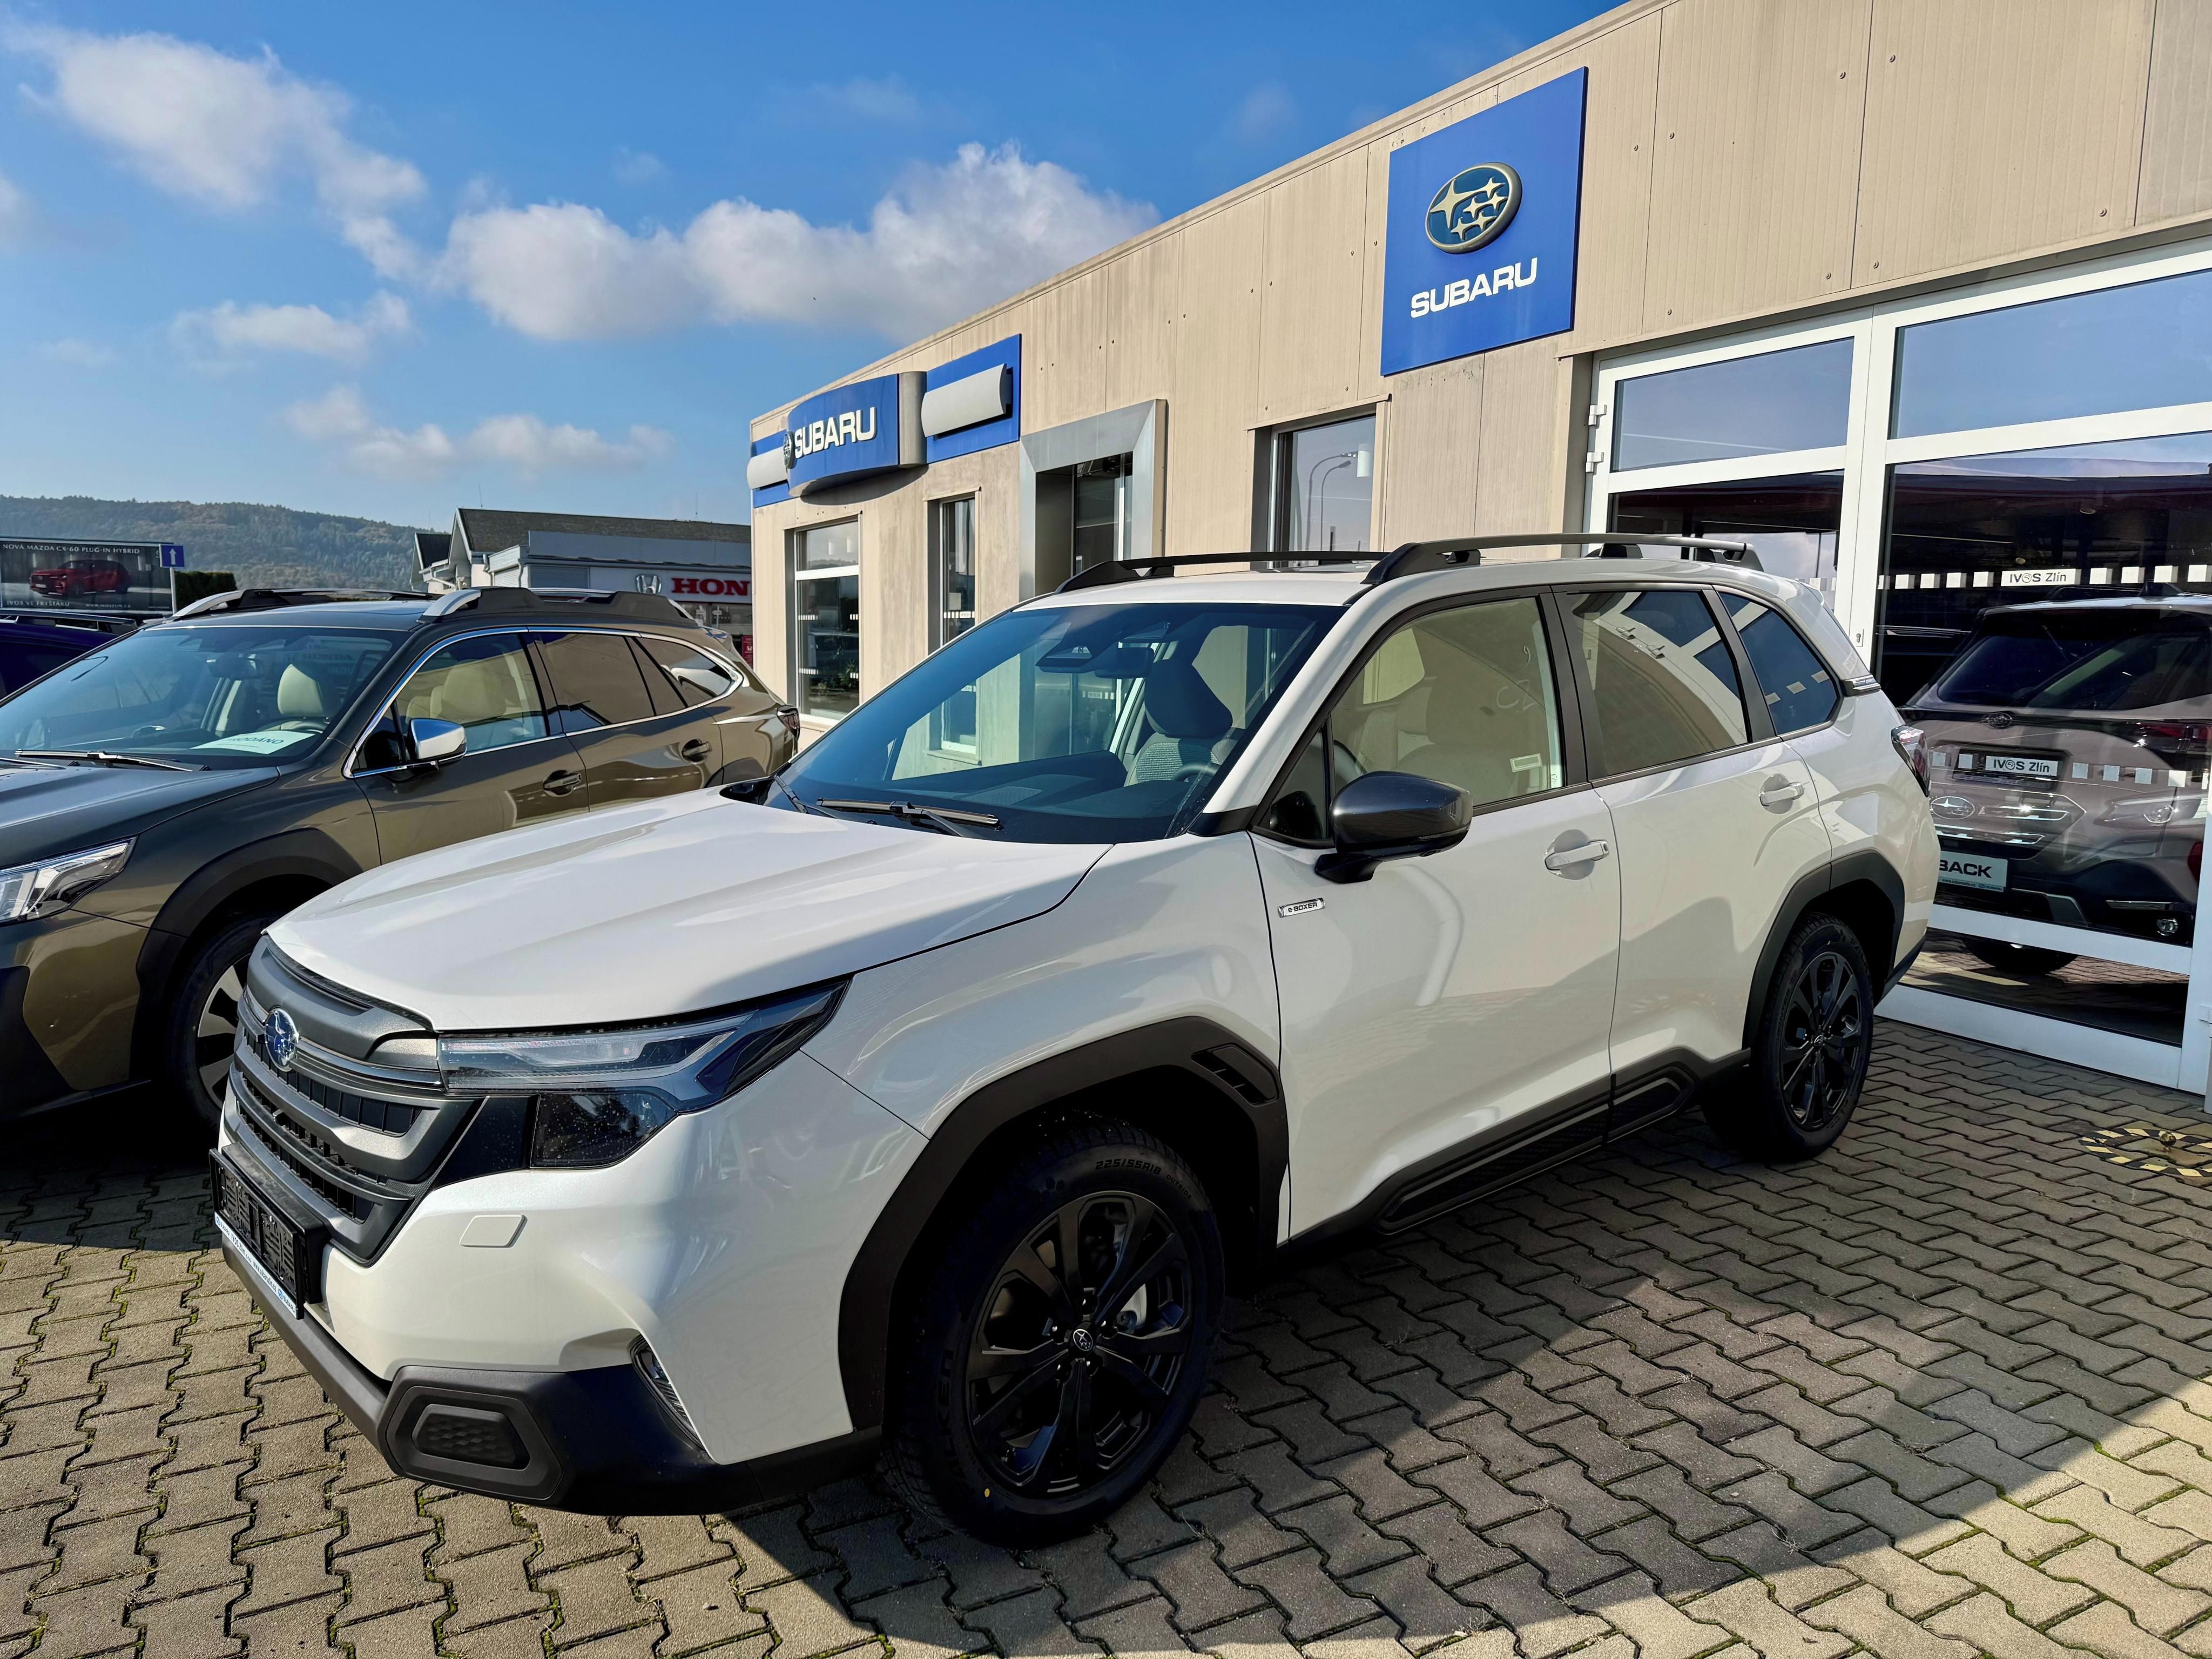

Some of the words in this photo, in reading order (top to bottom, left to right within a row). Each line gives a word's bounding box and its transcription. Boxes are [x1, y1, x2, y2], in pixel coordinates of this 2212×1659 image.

[1410, 257, 1538, 319] SUBARU
[794, 406, 877, 460] SUBARU
[671, 577, 751, 596] HON
[2009, 572, 2041, 583] IVOS
[2045, 571, 2067, 582] Zlín
[1993, 759, 2025, 771] IVOS
[2028, 762, 2050, 773] Zlín
[1939, 859, 1992, 879] BACK
[1288, 902, 1318, 913] e-BOXER
[1095, 1158, 1162, 1175] 225/55R18
[1166, 1174, 1192, 1199] OUTSIDE
